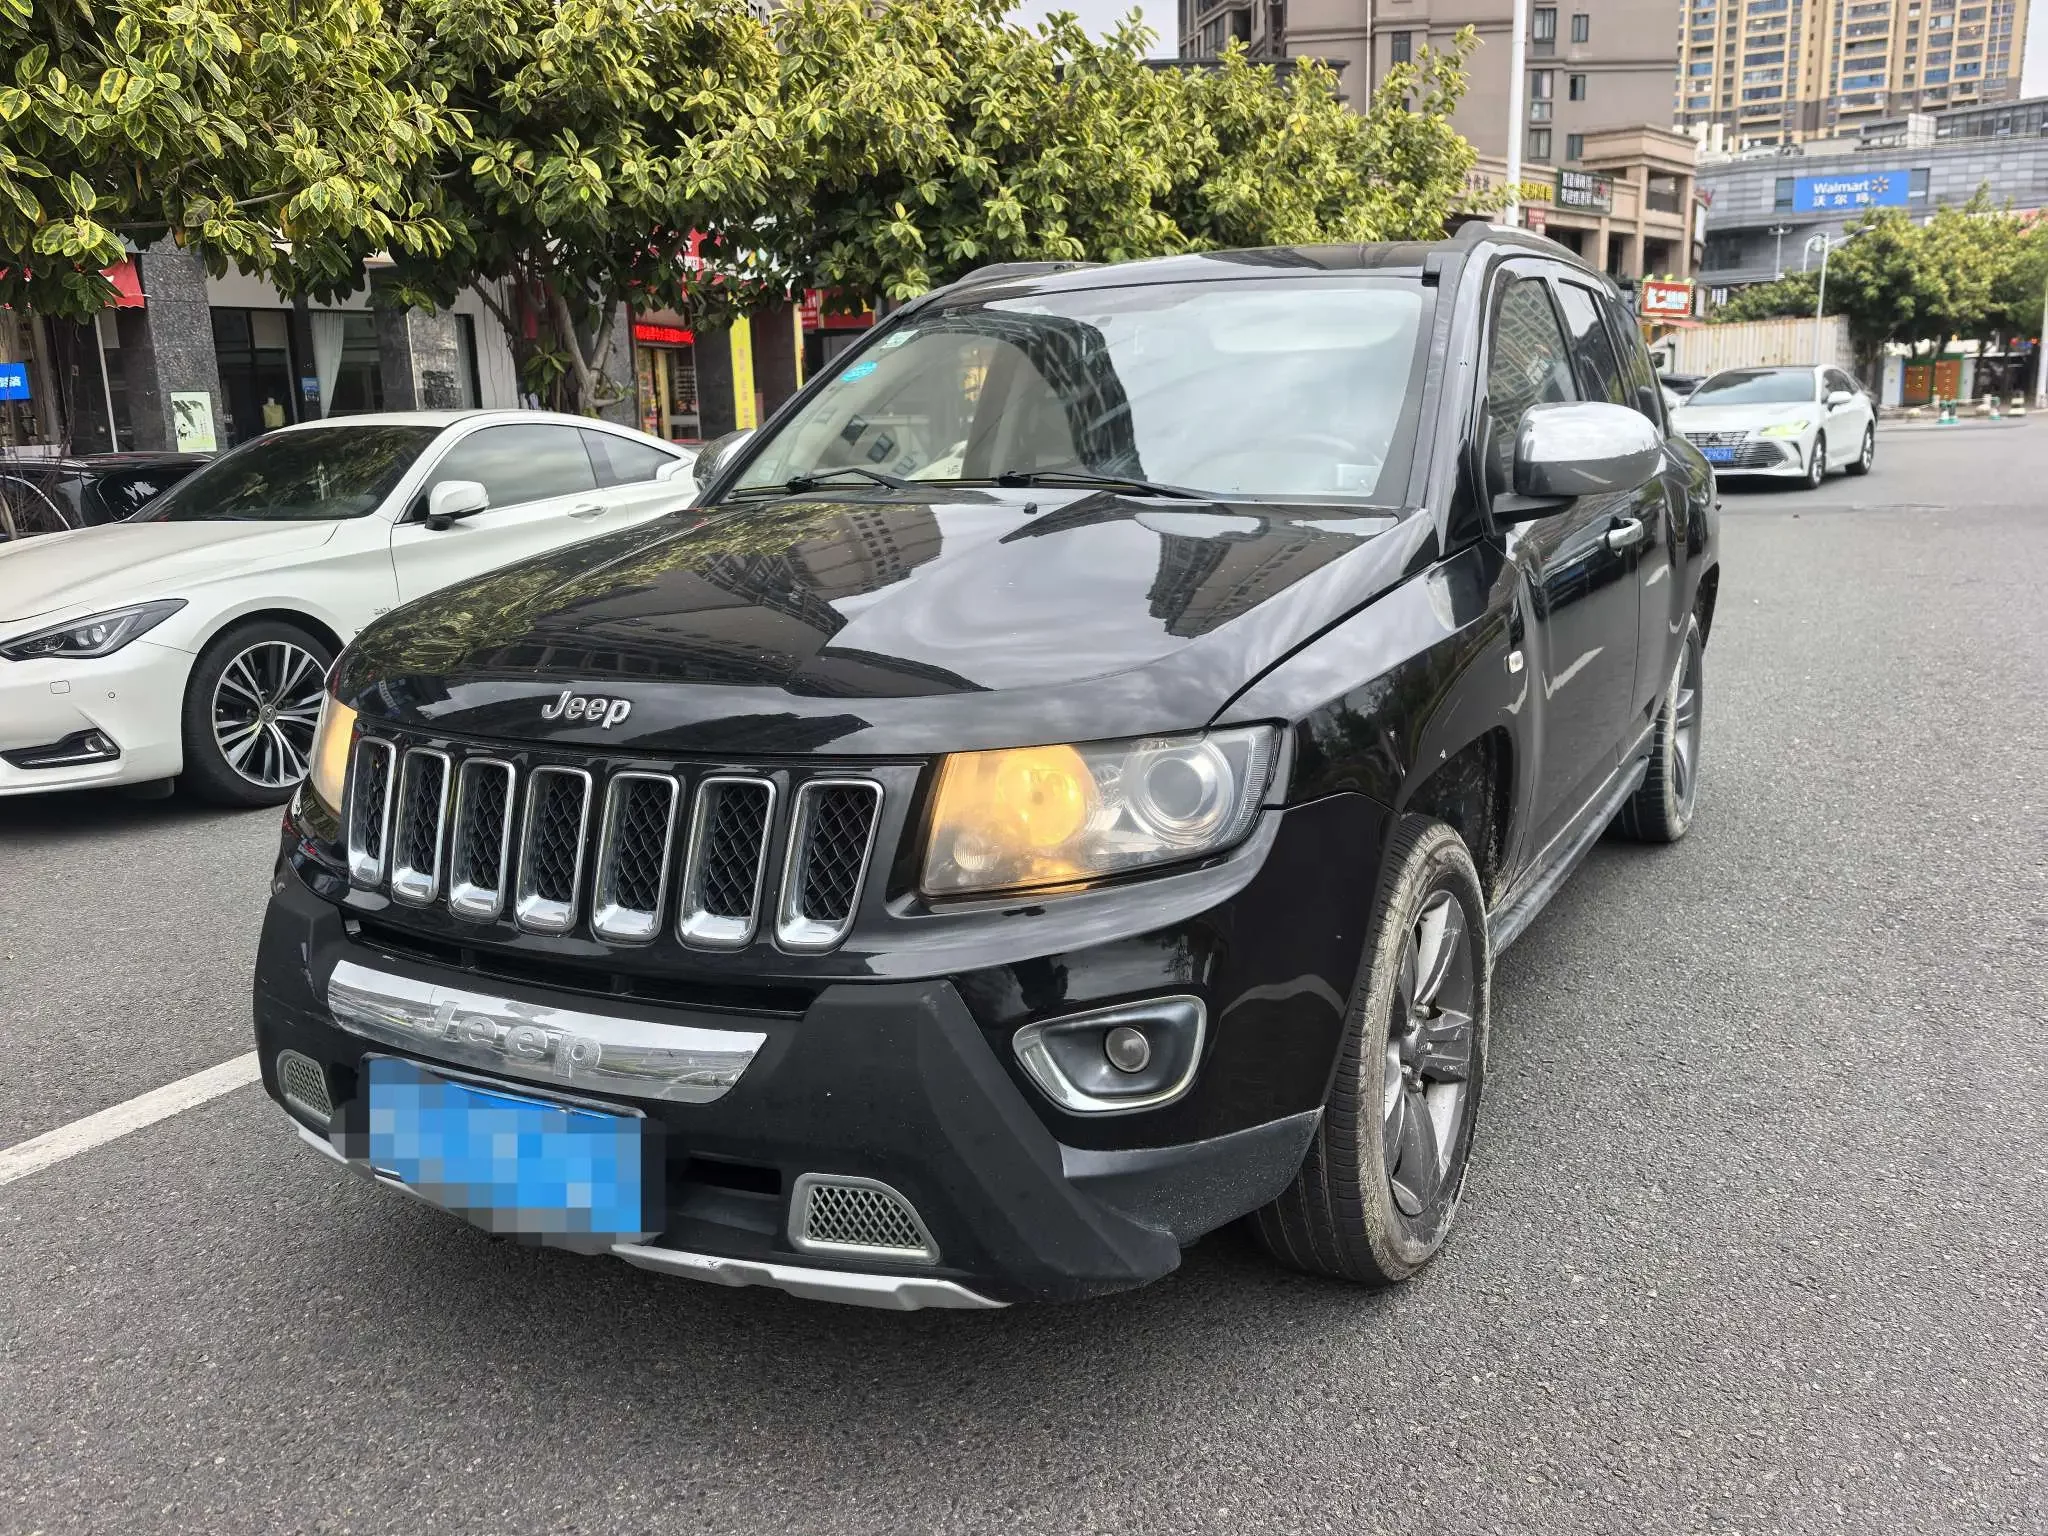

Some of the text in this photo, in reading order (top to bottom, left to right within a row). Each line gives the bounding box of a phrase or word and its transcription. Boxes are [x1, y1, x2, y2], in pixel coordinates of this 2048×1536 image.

[1812, 192, 1869, 207] 沃尔玛
[1813, 180, 1869, 194] Walmart
[541, 690, 632, 730] Jeep
[427, 1000, 601, 1079] Jeep
